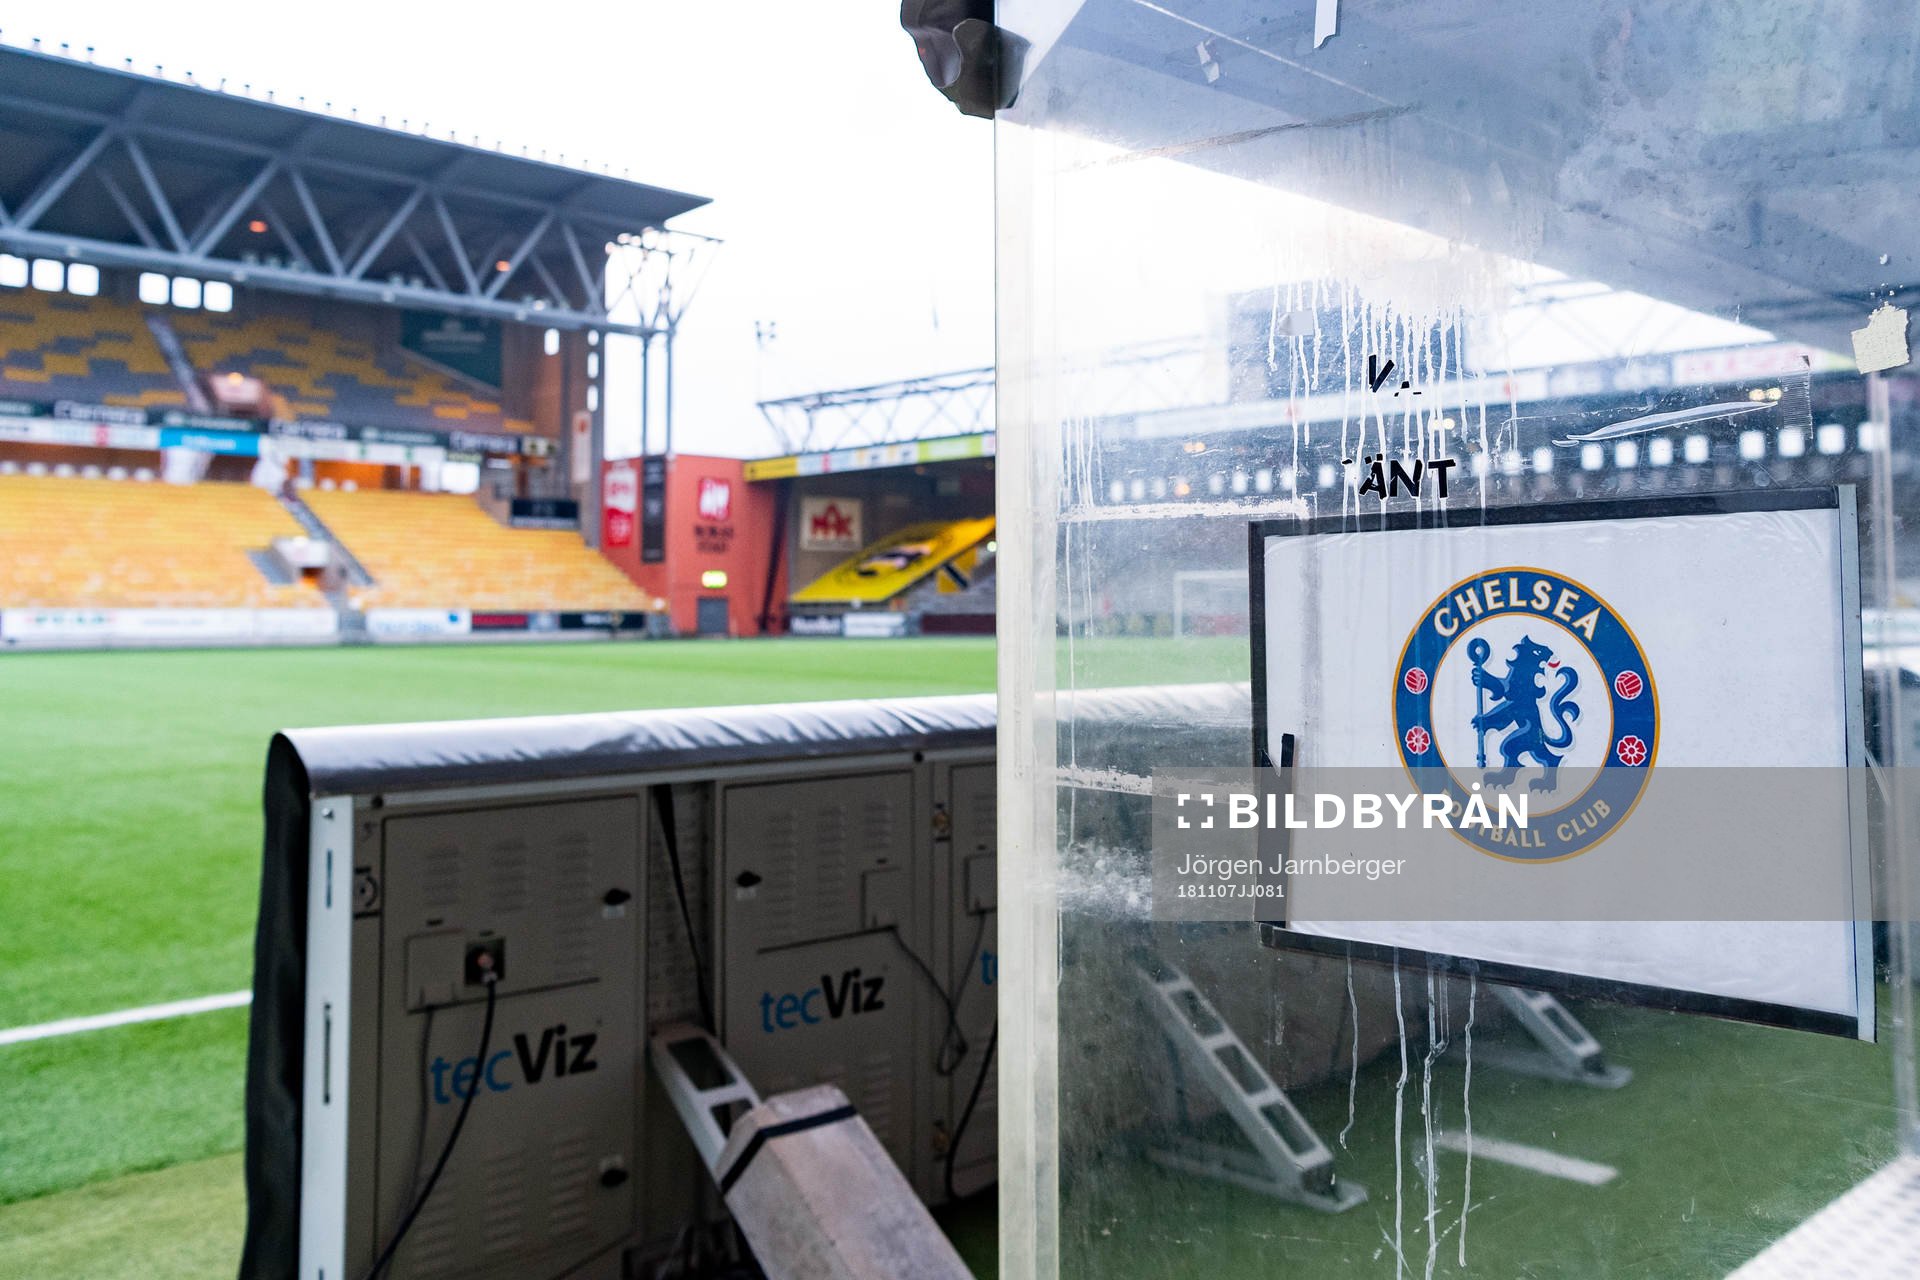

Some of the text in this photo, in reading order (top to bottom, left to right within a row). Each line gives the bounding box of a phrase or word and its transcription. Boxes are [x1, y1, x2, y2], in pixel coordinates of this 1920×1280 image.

[1434, 577, 1602, 642] CHELSEA
[1556, 798, 1612, 842] CLUB
[760, 968, 885, 1033] tecViz
[430, 1023, 598, 1105] tecViz
